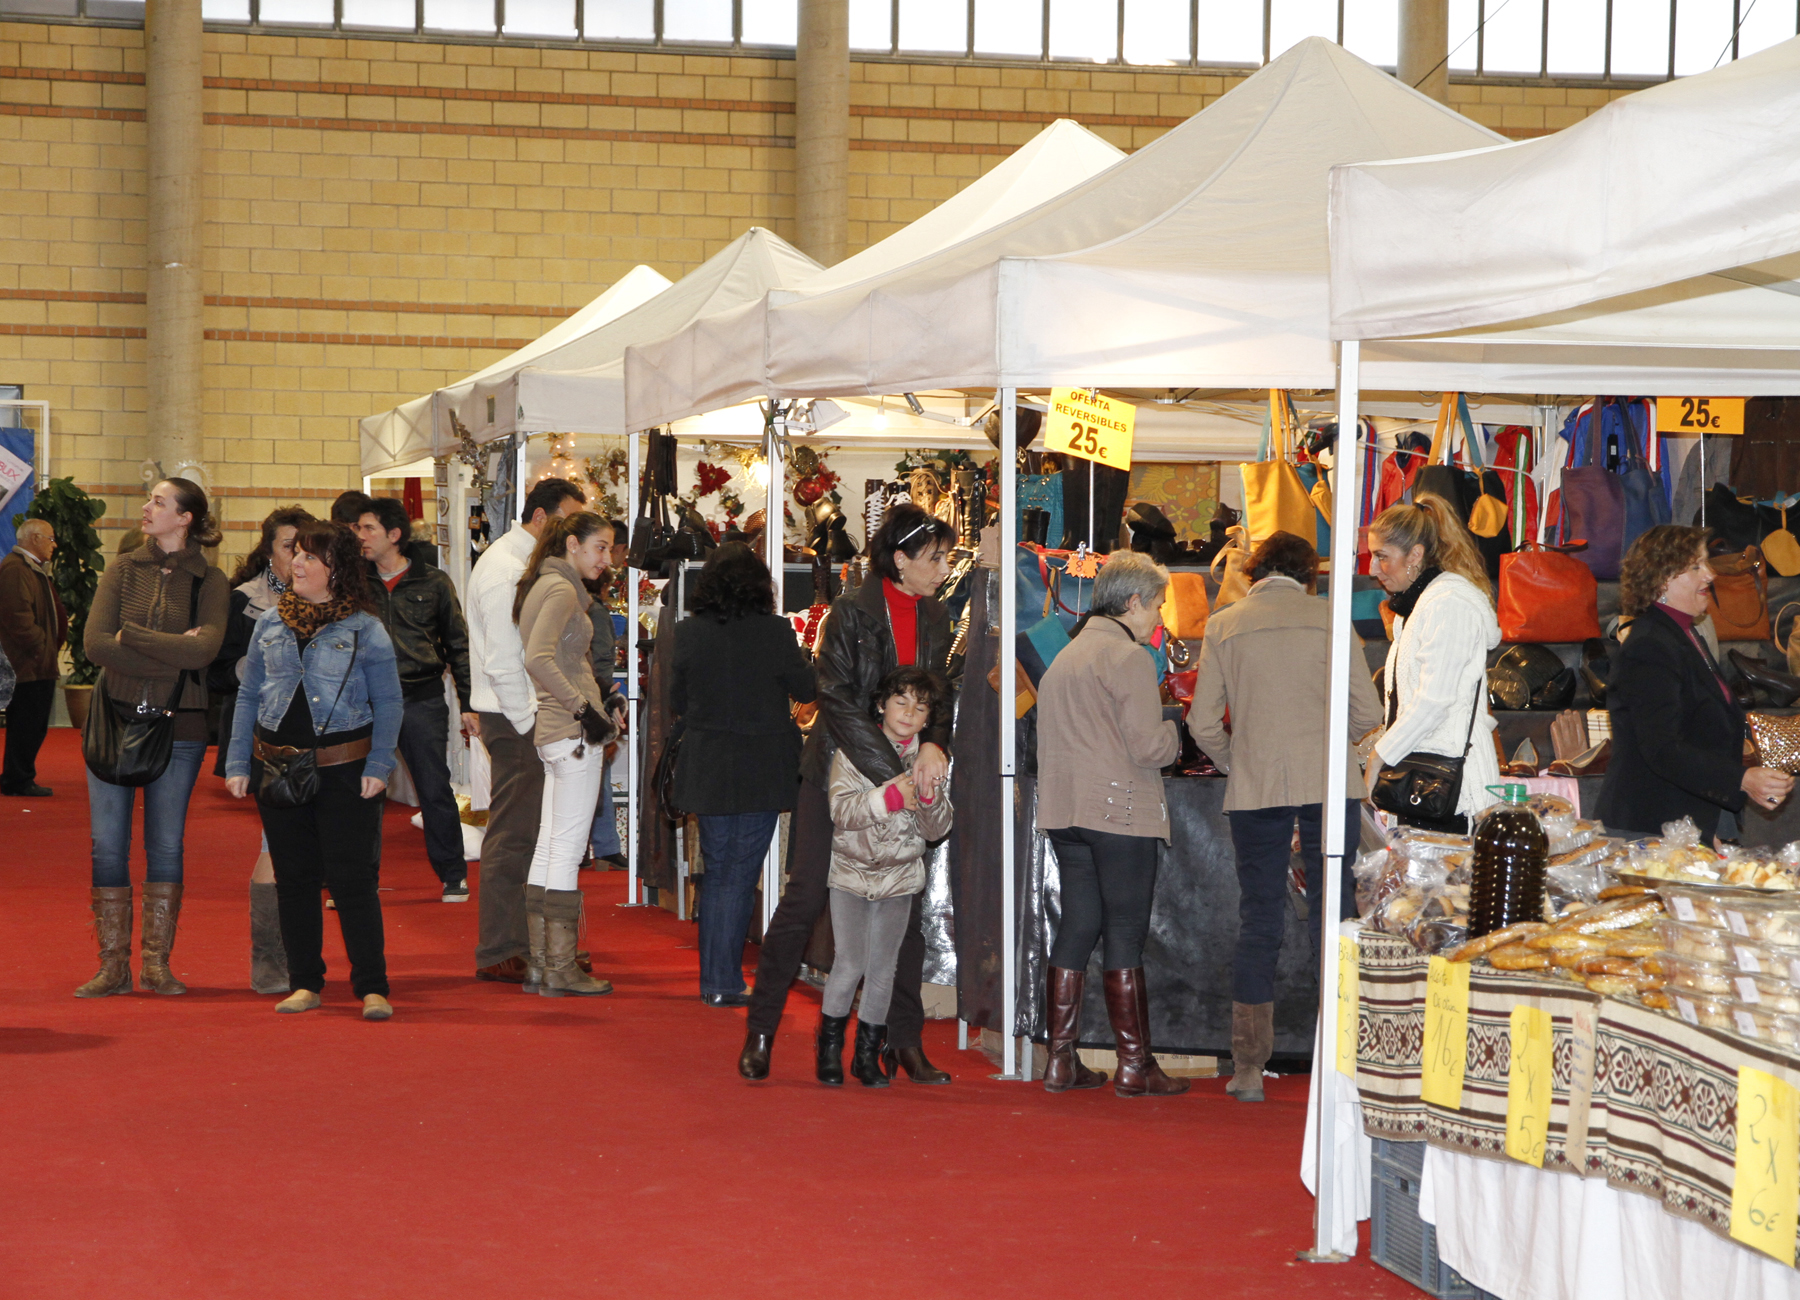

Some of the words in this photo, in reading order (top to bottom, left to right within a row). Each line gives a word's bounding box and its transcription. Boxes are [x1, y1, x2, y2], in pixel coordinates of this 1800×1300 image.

[1055, 403, 1127, 433] REVERSIBLES
[1070, 391, 1111, 412] OFERTA
[1680, 397, 1720, 428] 25€
[1068, 421, 1108, 459] 25€
[1749, 1094, 1767, 1145] 2
[1748, 1188, 1781, 1232] 6€
